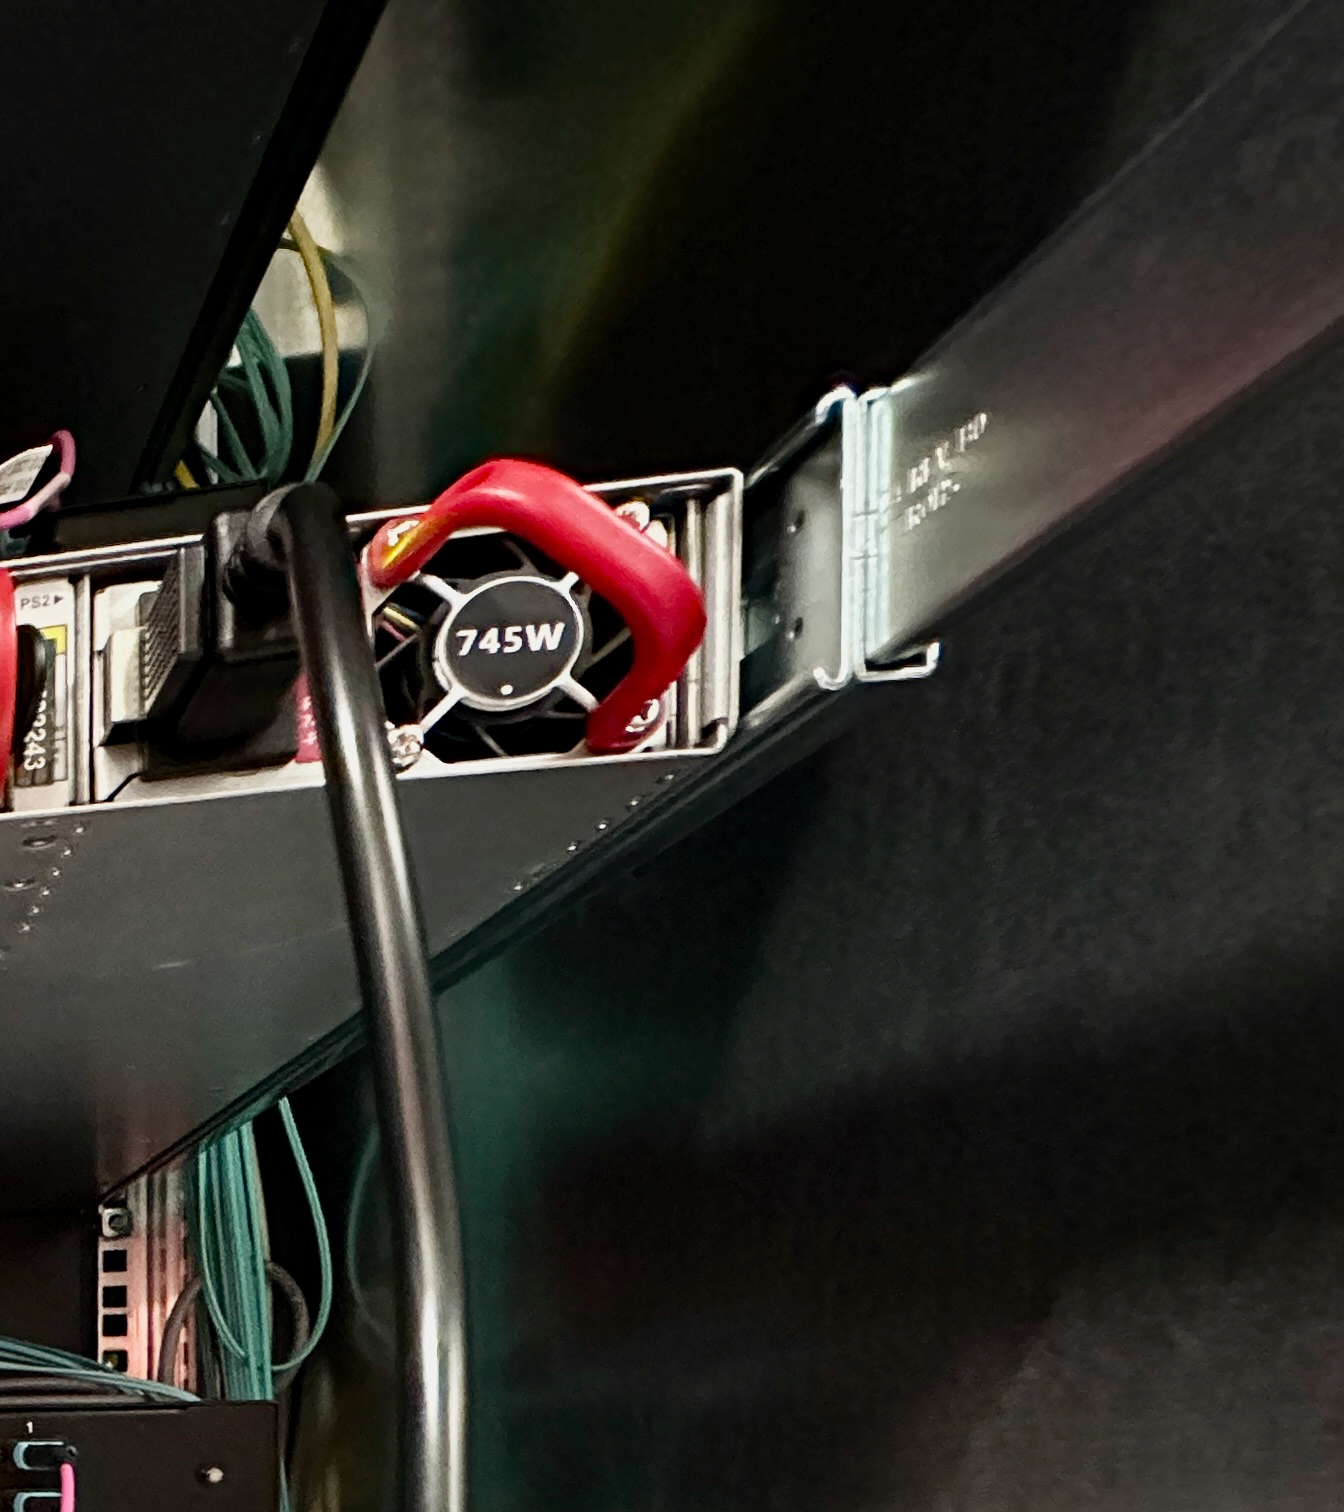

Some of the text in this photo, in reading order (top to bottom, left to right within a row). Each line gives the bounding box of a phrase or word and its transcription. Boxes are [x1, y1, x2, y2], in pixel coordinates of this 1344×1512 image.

[20, 594, 51, 610] PS2
[455, 622, 565, 656] 745W
[25, 1421, 34, 1433] 1
